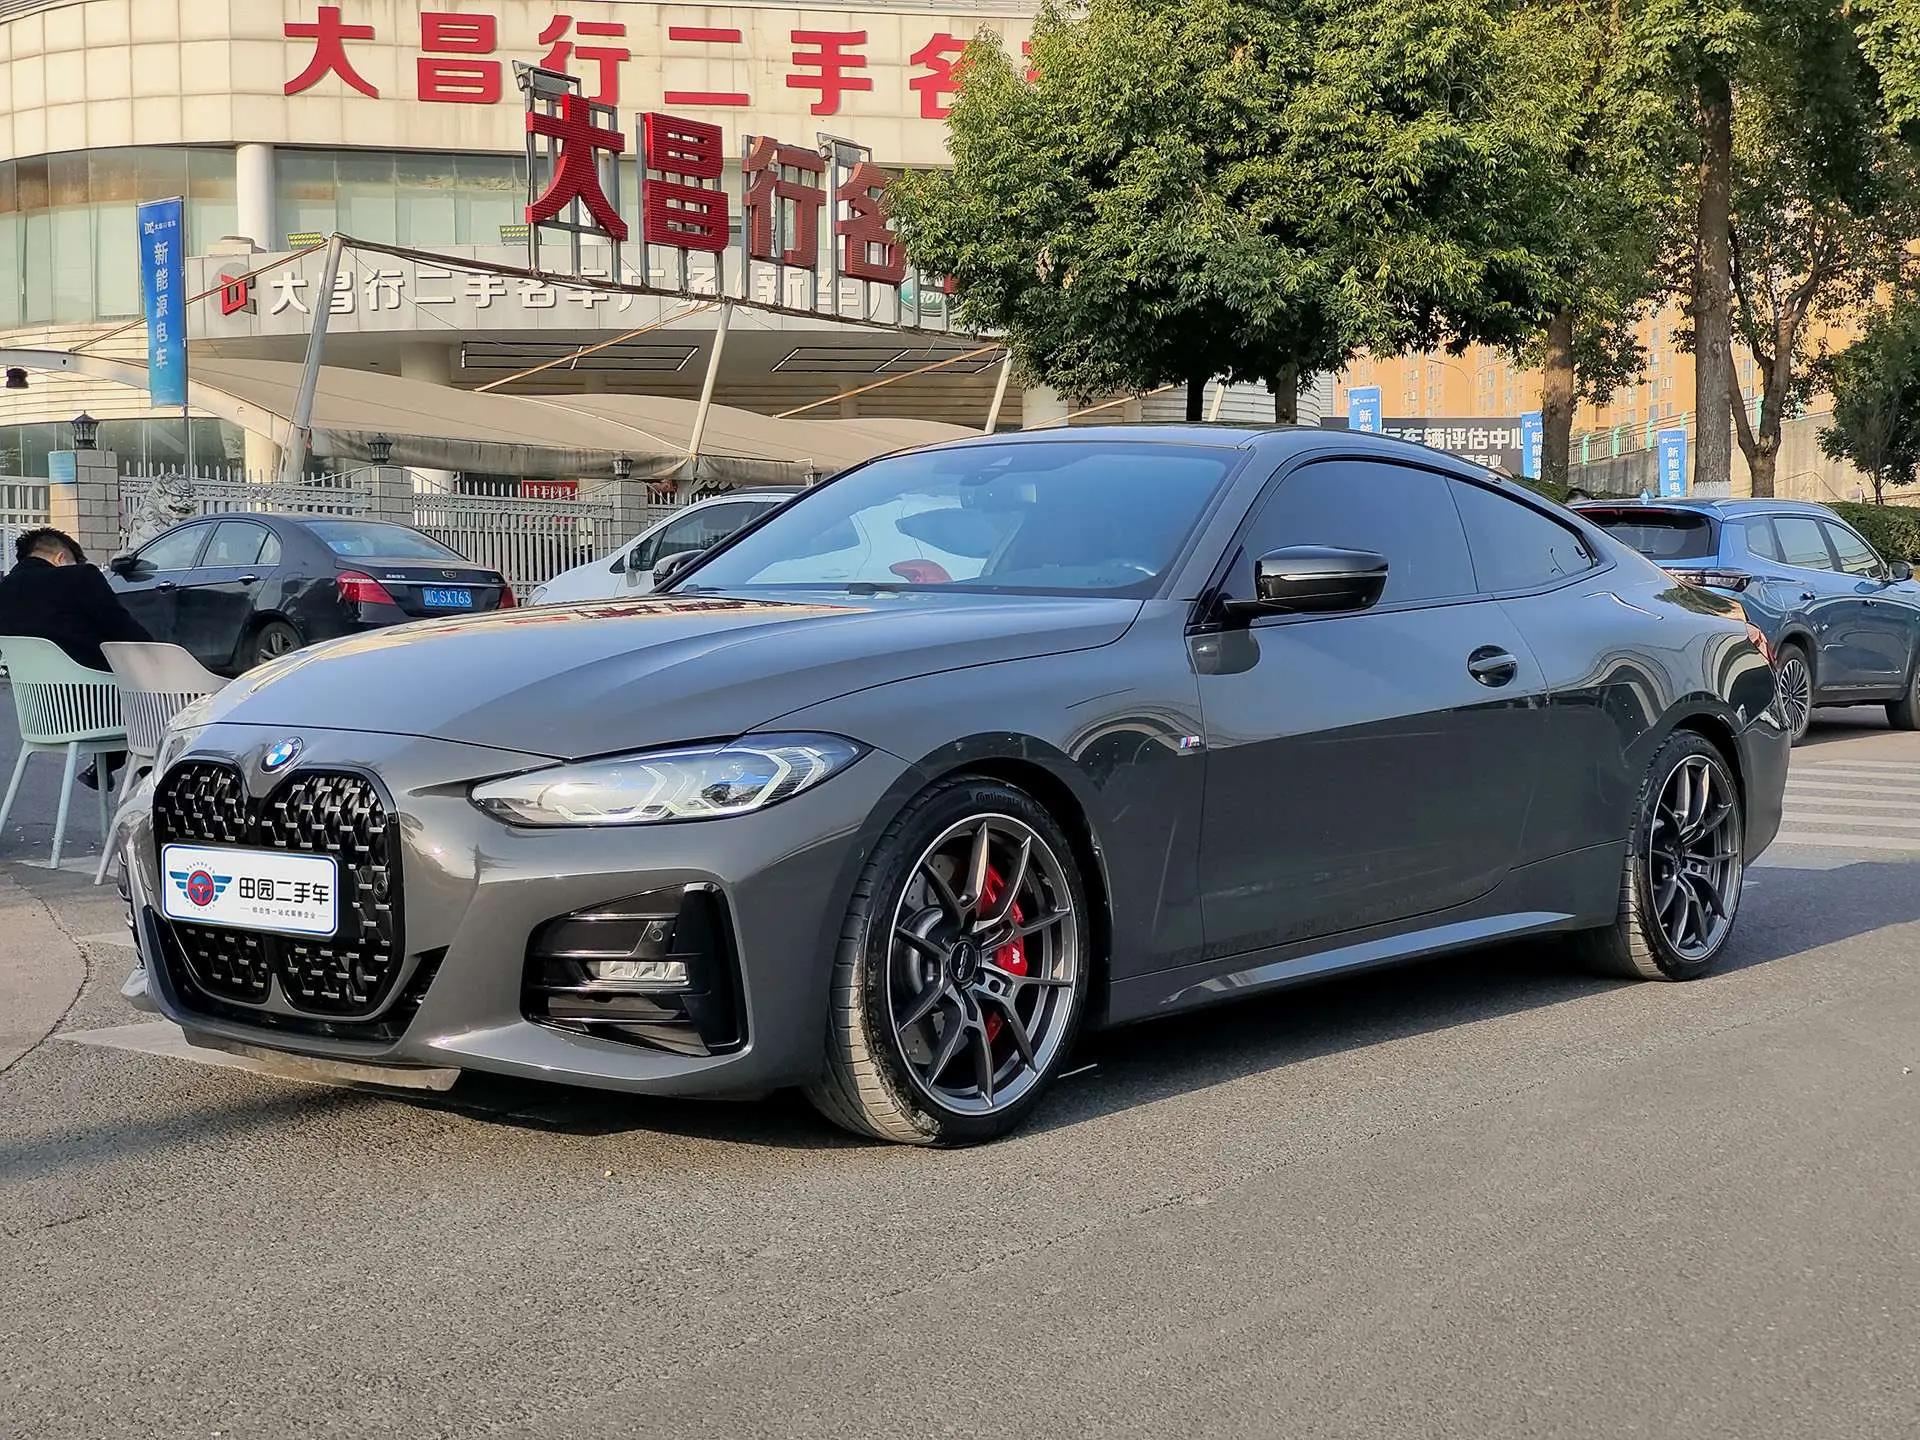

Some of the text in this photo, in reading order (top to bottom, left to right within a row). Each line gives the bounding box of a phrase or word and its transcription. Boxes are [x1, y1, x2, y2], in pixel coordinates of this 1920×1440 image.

[284, 6, 1041, 119] 大昌行二手名
[525, 94, 959, 294] 大昌行名
[153, 240, 169, 369] 新能源电车
[239, 877, 329, 905] 田园二手车
